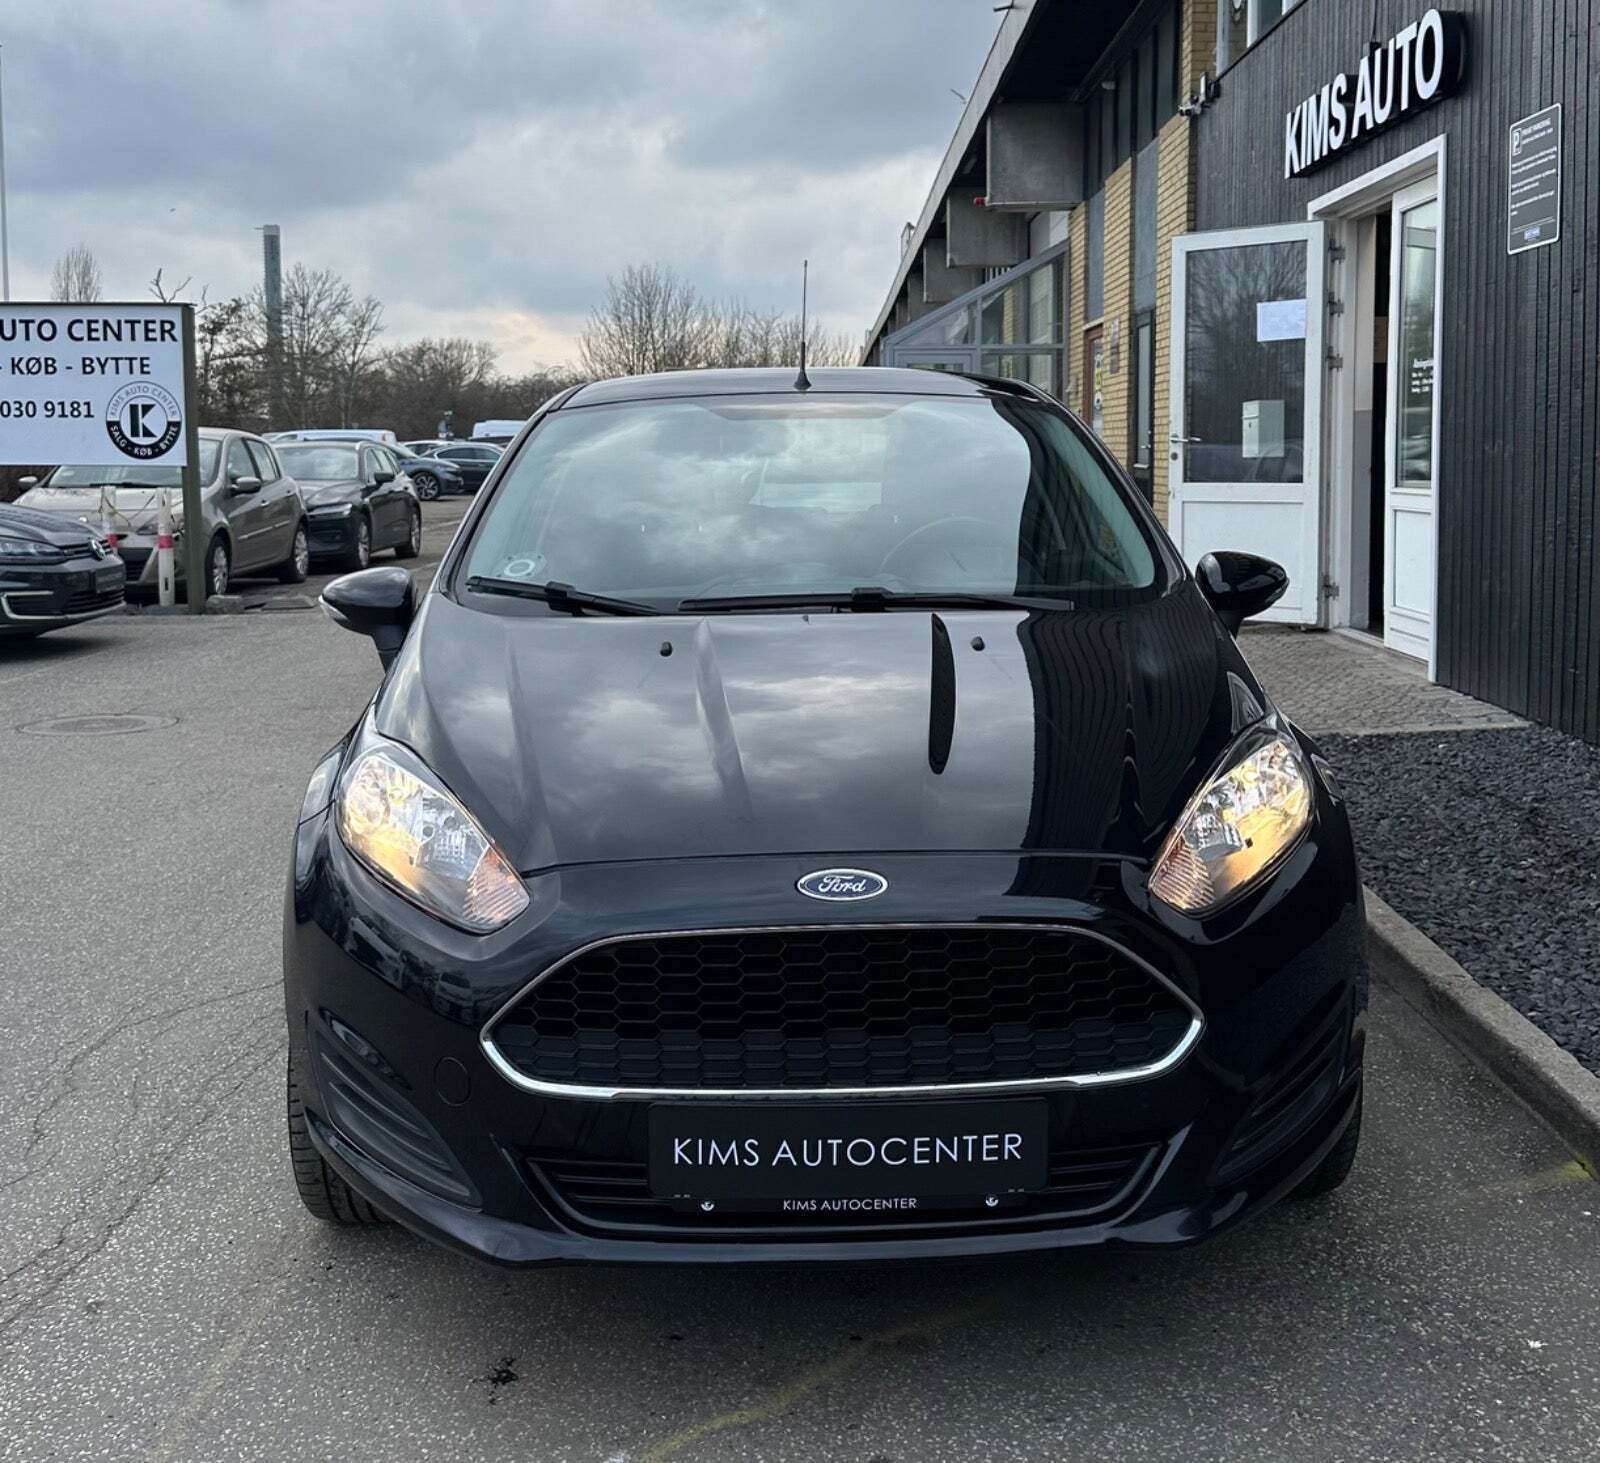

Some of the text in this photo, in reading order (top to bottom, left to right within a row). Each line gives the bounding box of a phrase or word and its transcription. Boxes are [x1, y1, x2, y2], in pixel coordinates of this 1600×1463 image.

[1285, 8, 1444, 179] KIMS AUTO
[67, 319, 178, 342] CENTER
[11, 356, 57, 375] KØB
[81, 357, 151, 375] BYTTE
[44, 401, 95, 418] 9181
[125, 385, 149, 397] AUTO
[151, 387, 178, 416] CENTER
[128, 403, 158, 437] K
[110, 425, 128, 447] SALG
[134, 447, 153, 456] KØB
[159, 426, 178, 450] BYTTE
[818, 875, 867, 892] Ford
[674, 1133, 1023, 1167] KIMS AUTOCENTER
[783, 1197, 917, 1211] KIMS AUTOCENTER
